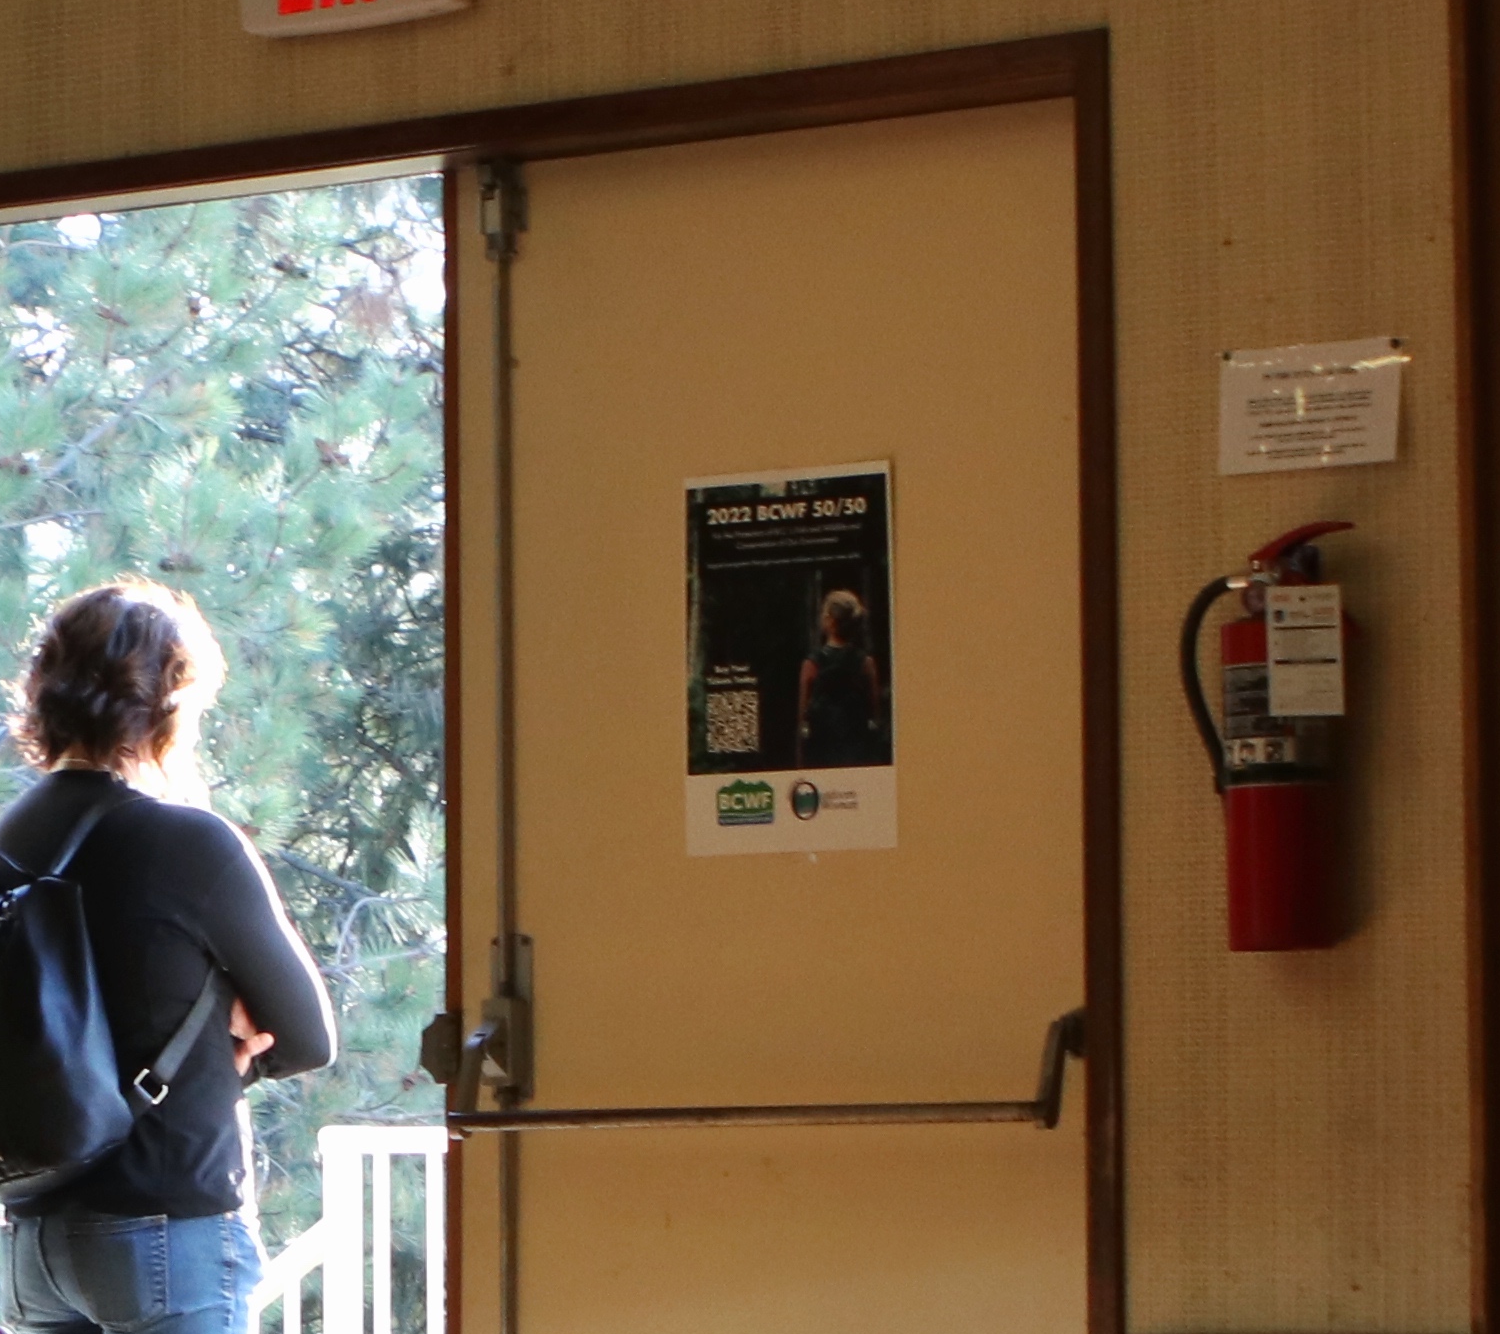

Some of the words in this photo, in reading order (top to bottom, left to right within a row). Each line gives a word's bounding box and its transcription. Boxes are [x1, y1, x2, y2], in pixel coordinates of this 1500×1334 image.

[707, 505, 752, 525] 2022
[756, 502, 808, 522] BCWF
[812, 497, 867, 518] 50/50
[719, 793, 772, 810] BCWF
